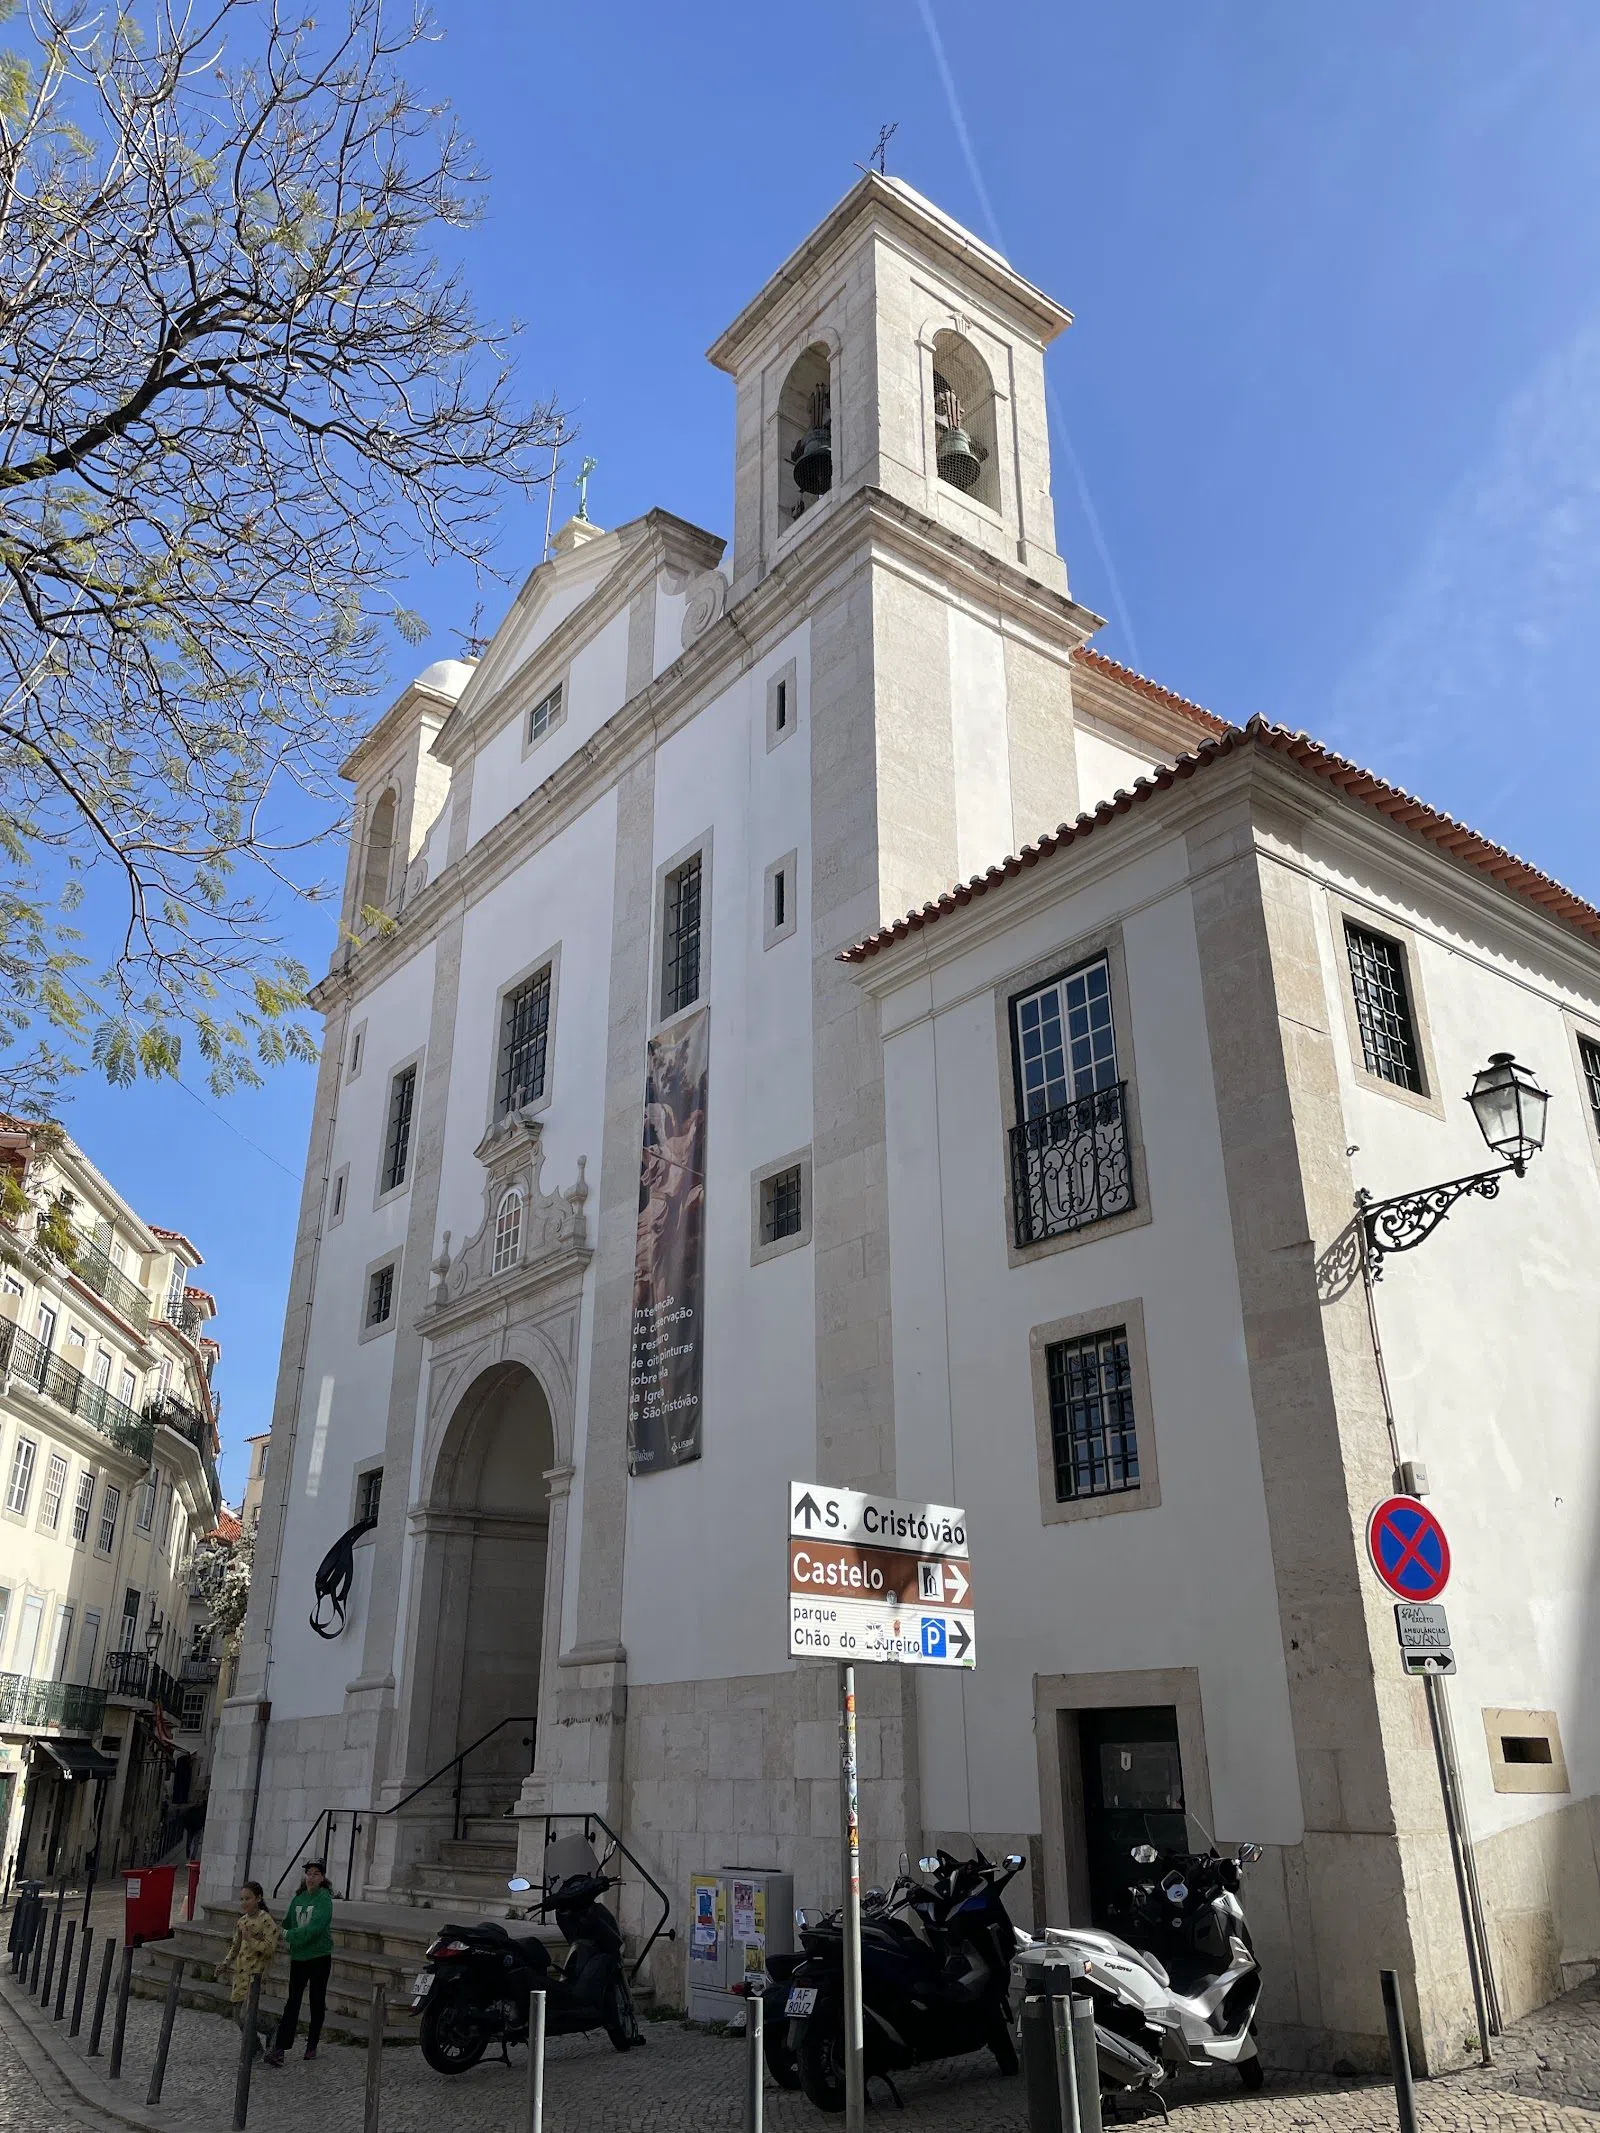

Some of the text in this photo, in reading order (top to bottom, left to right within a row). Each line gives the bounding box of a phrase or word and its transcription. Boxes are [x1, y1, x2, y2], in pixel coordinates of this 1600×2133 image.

[634, 1296, 675, 1319] Inteenção
[633, 1323, 647, 1335] de
[632, 1343, 693, 1369] de oit pinturas
[631, 1372, 657, 1386] sobre
[630, 1388, 665, 1405] da Igrea
[629, 1409, 639, 1421] de
[643, 1406, 660, 1419] São
[825, 1501, 965, 1545] S. Cristóvão
[793, 1552, 884, 1590] Castelo
[793, 1607, 837, 1622] parque
[794, 1628, 830, 1647] Chão
[840, 1632, 856, 1648] do
[927, 1626, 940, 1654] P
